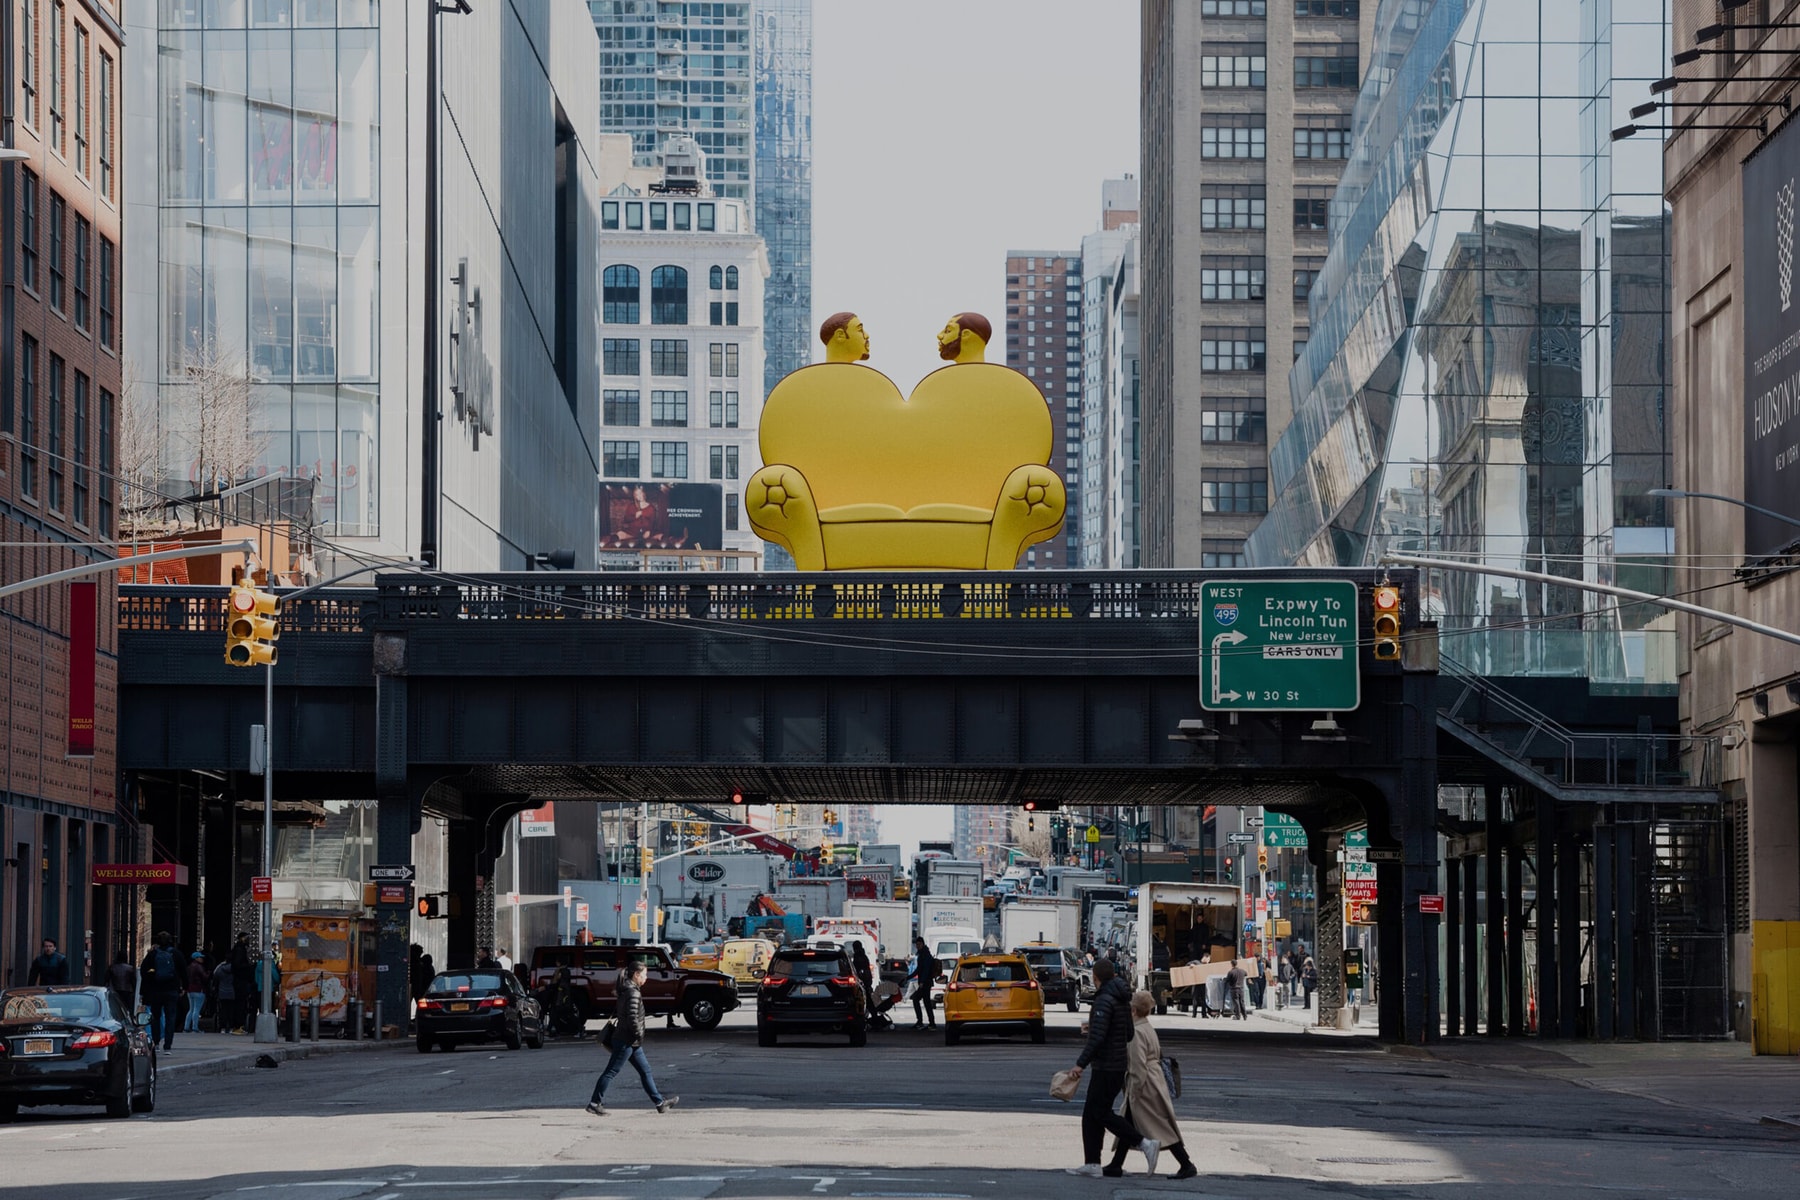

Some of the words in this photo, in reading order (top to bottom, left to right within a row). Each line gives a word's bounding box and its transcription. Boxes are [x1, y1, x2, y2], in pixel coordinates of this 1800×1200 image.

[1754, 358, 1763, 376] THE
[1763, 346, 1778, 372] SHOPS
[1754, 378, 1791, 441] HUDSON
[1775, 452, 1786, 472] NEW
[1786, 442, 1799, 465] YORK
[1210, 588, 1243, 598] WEST
[1265, 597, 1318, 613] Expwy
[1324, 597, 1341, 610] To
[1216, 610, 1236, 620] 495
[1259, 615, 1314, 627] Lincoln
[1320, 615, 1347, 627] Tun
[1270, 631, 1293, 640] New
[1298, 631, 1336, 643] Jersey
[1268, 647, 1302, 656] CARS
[1305, 647, 1338, 656] ONLY
[1247, 691, 1256, 701] W
[1263, 691, 1280, 701] 30
[1286, 691, 1299, 701] St
[97, 870, 133, 878] WELLS
[136, 870, 171, 878] FARGO
[375, 869, 389, 877] ONE
[394, 869, 409, 877] WAY
